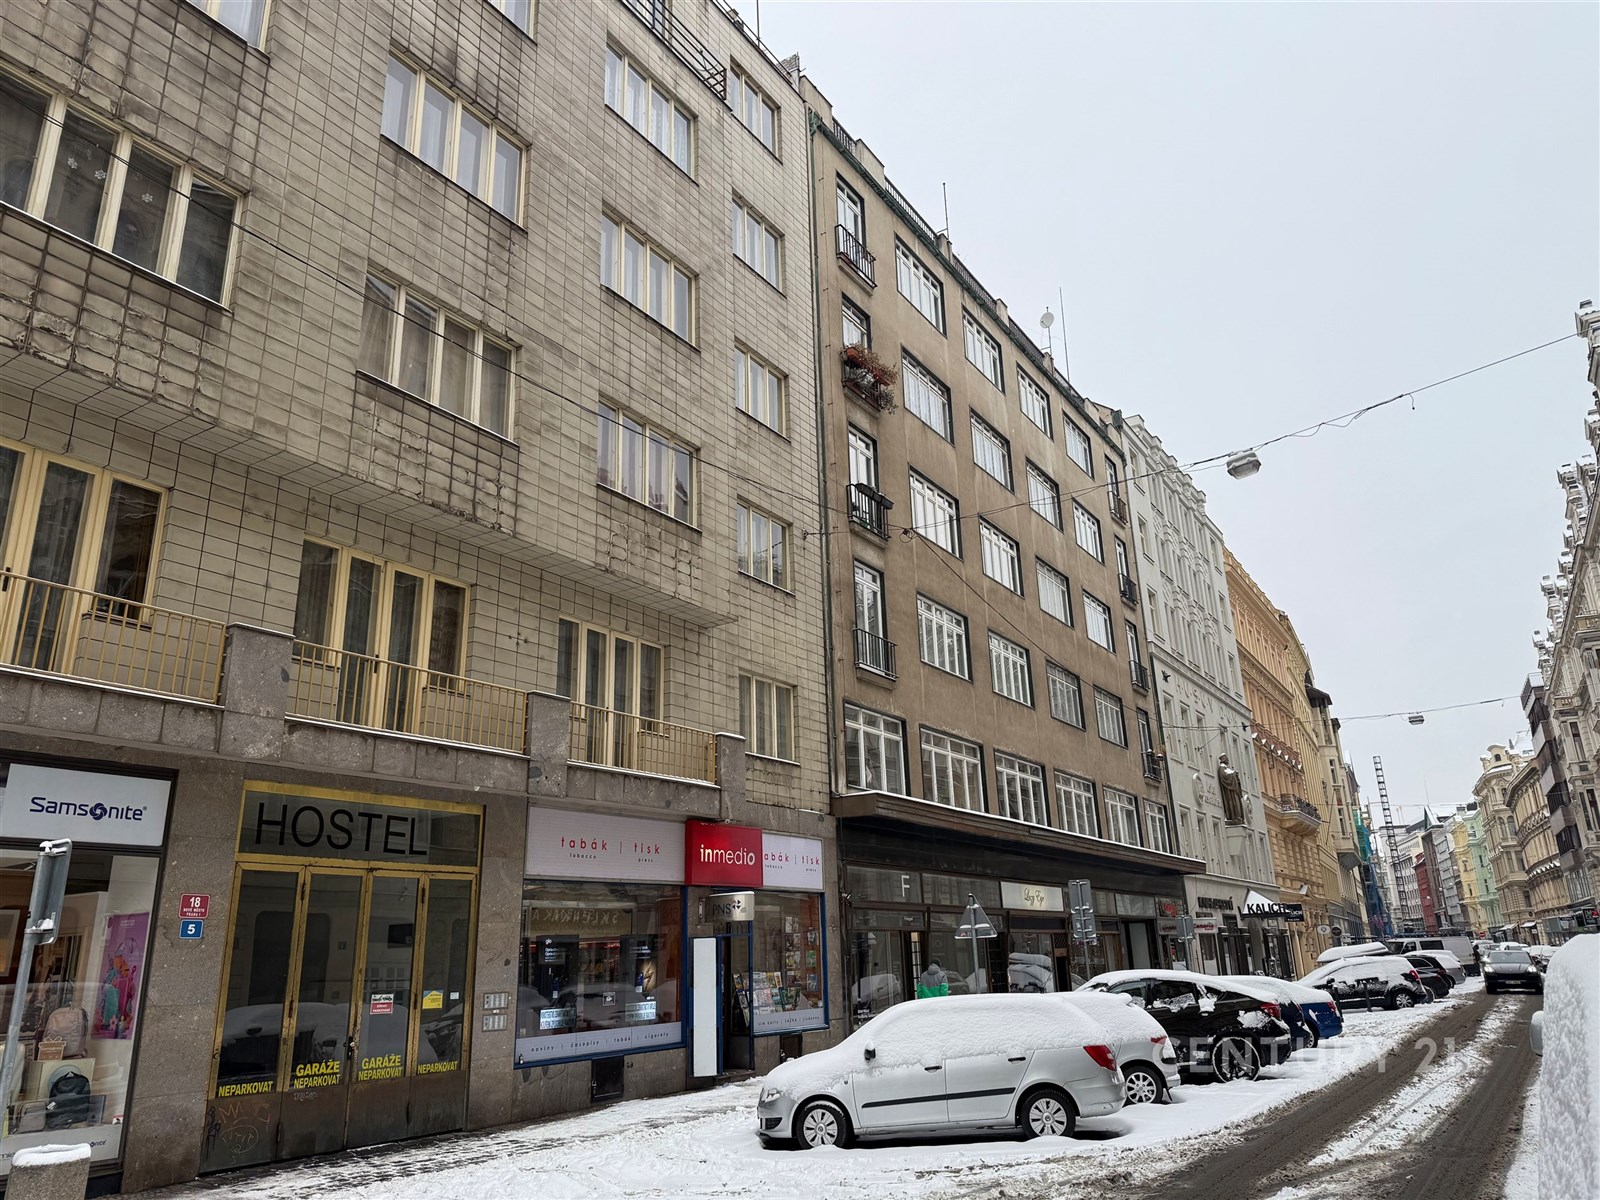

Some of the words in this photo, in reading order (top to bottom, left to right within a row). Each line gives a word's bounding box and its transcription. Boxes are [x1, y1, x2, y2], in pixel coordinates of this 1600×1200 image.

[29, 796, 144, 821] Samsonite
[255, 802, 427, 855] HOSTEL
[561, 836, 607, 851] tabák
[634, 842, 660, 855] tisk
[569, 852, 597, 860] tobacco
[700, 843, 756, 866] inmedio
[763, 851, 790, 862] abák
[802, 855, 820, 866] tisk
[901, 875, 910, 898] F
[190, 896, 201, 908] 18
[712, 903, 732, 915] PNS
[1246, 902, 1287, 915] KALICH
[187, 924, 196, 935] 5
[570, 1041, 599, 1049] časopisy
[296, 1059, 341, 1078] GARÁŽE
[361, 1053, 402, 1070] GARÁŽE
[417, 1060, 458, 1075] NEPARKOVAT
[358, 1066, 403, 1081] NEPARKOVAT
[218, 1081, 274, 1097] NEPARKOVAT
[293, 1073, 341, 1090] NEPARKOVAT
